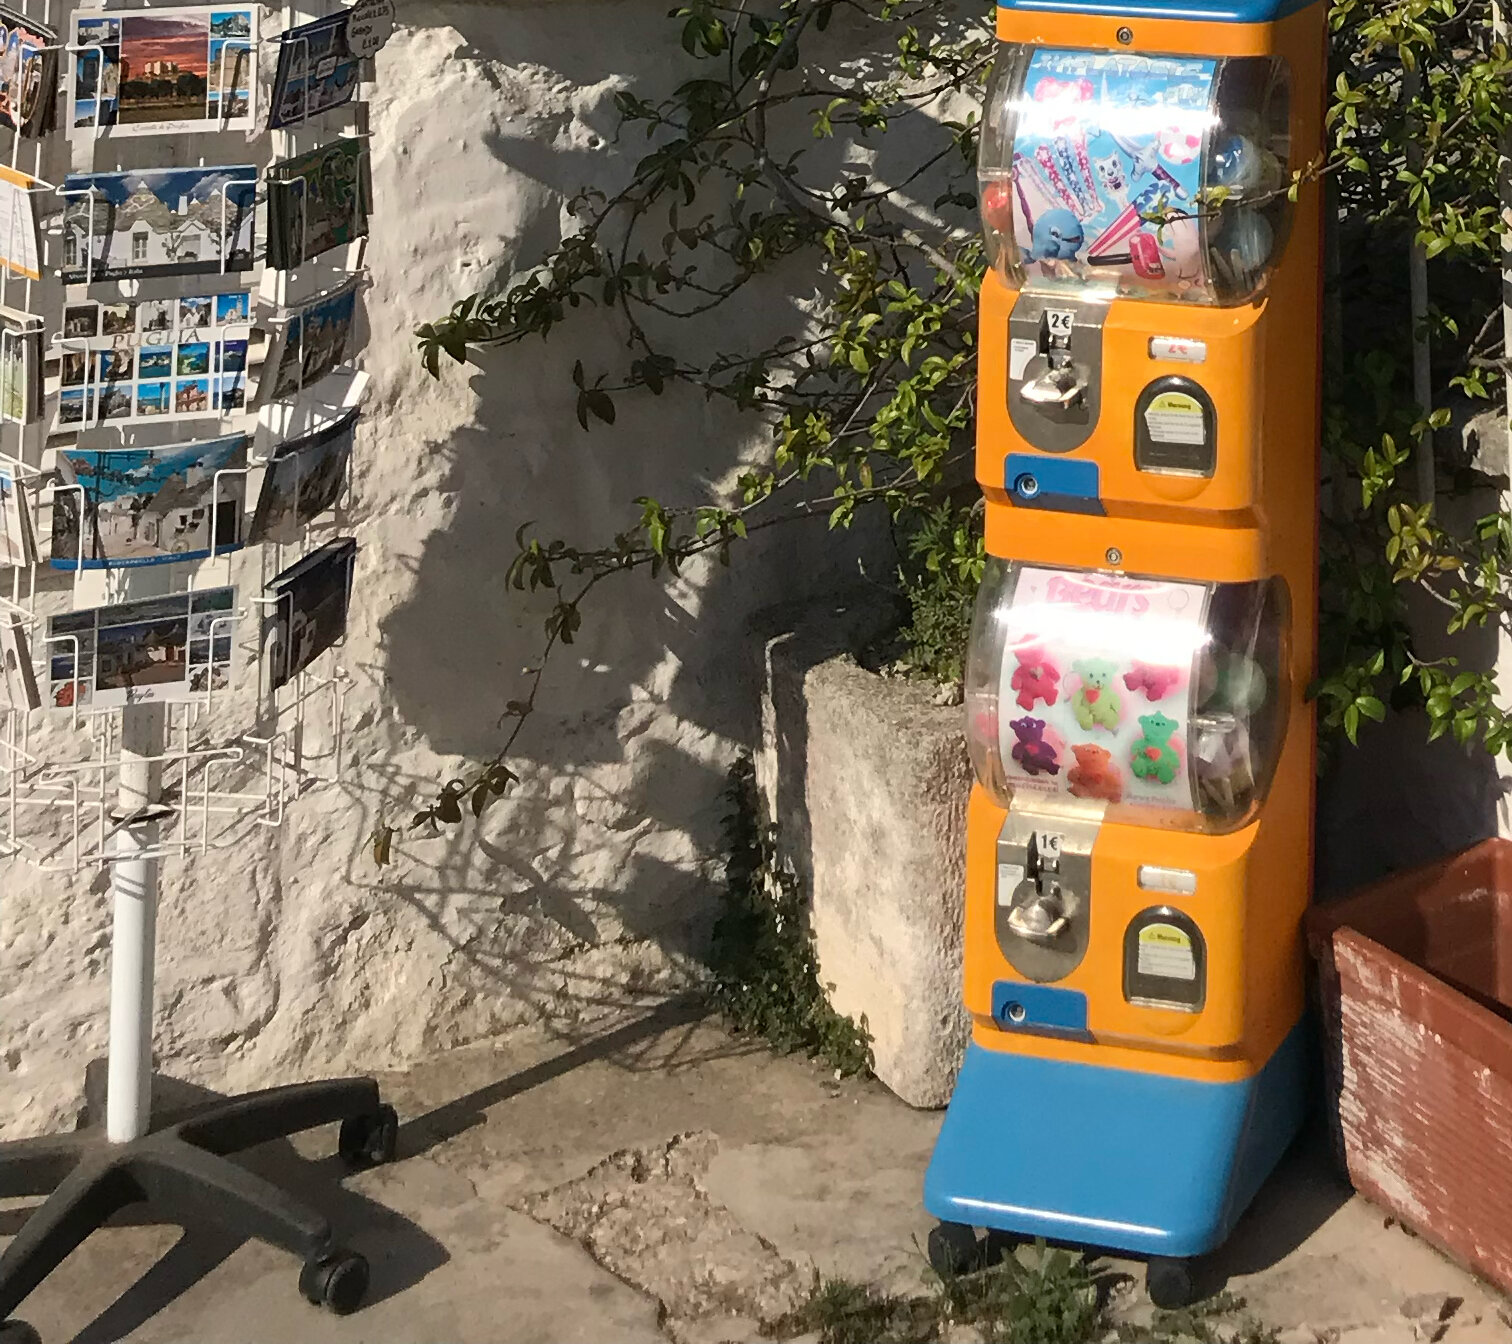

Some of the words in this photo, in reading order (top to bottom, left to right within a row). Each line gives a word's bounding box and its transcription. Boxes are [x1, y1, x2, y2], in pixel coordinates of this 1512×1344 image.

[1051, 314, 1070, 329] 2€
[111, 328, 200, 349] PUGLIA
[1041, 834, 1059, 851] 1€
